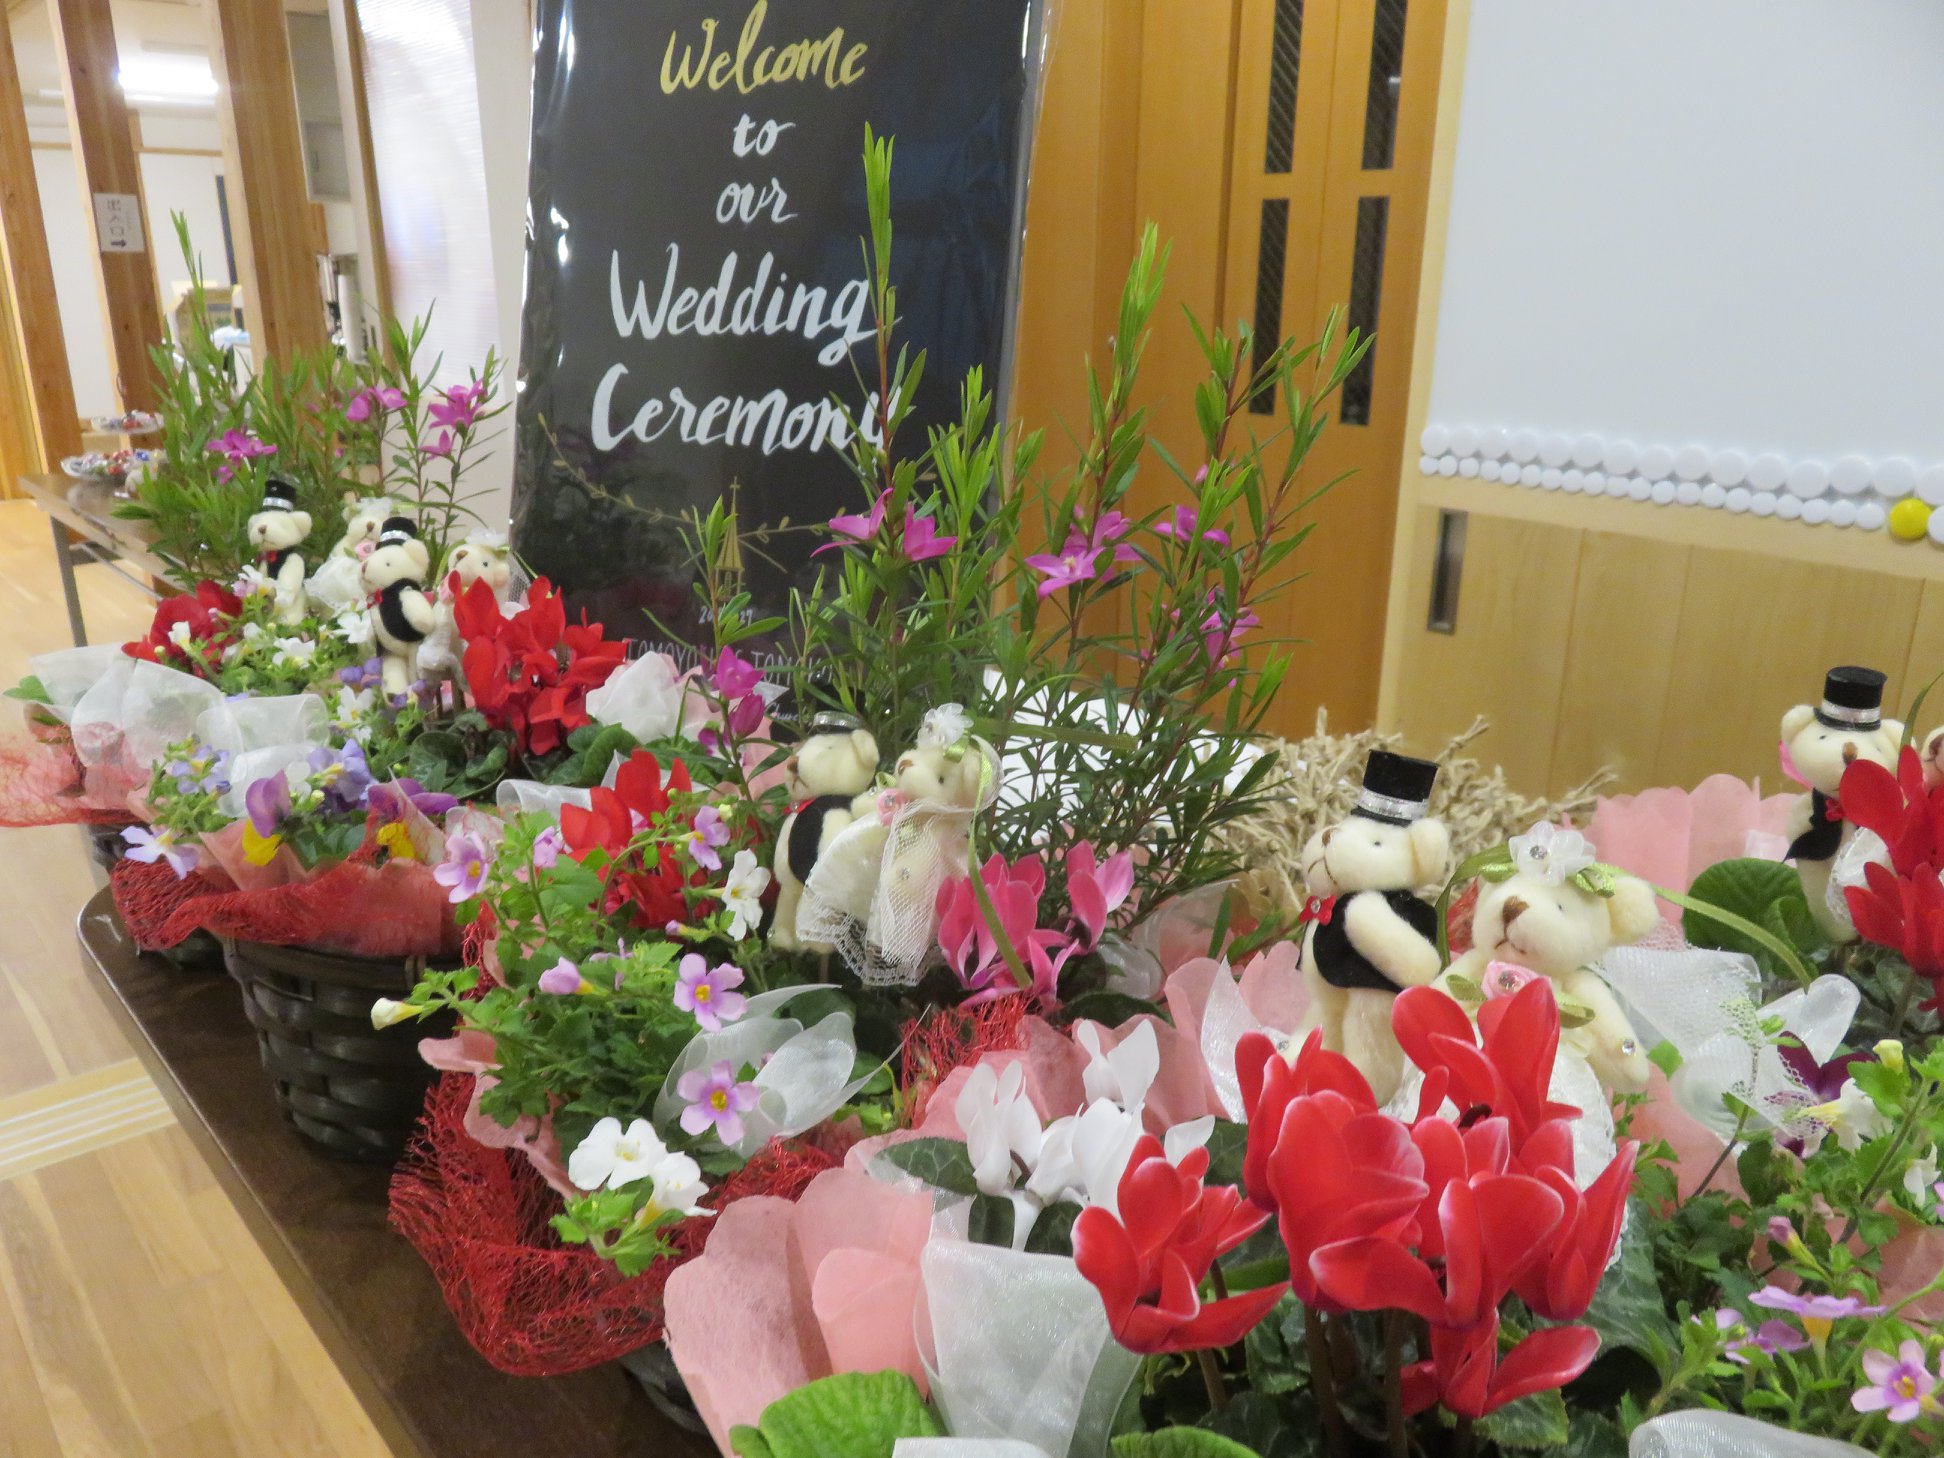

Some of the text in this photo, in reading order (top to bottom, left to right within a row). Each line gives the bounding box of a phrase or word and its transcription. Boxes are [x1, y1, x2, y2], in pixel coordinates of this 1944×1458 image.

[660, 0, 868, 94] Welcome
[733, 113, 796, 157] to
[716, 177, 798, 224] our
[610, 242, 902, 366] Wedding
[591, 362, 902, 478] Ceremony
